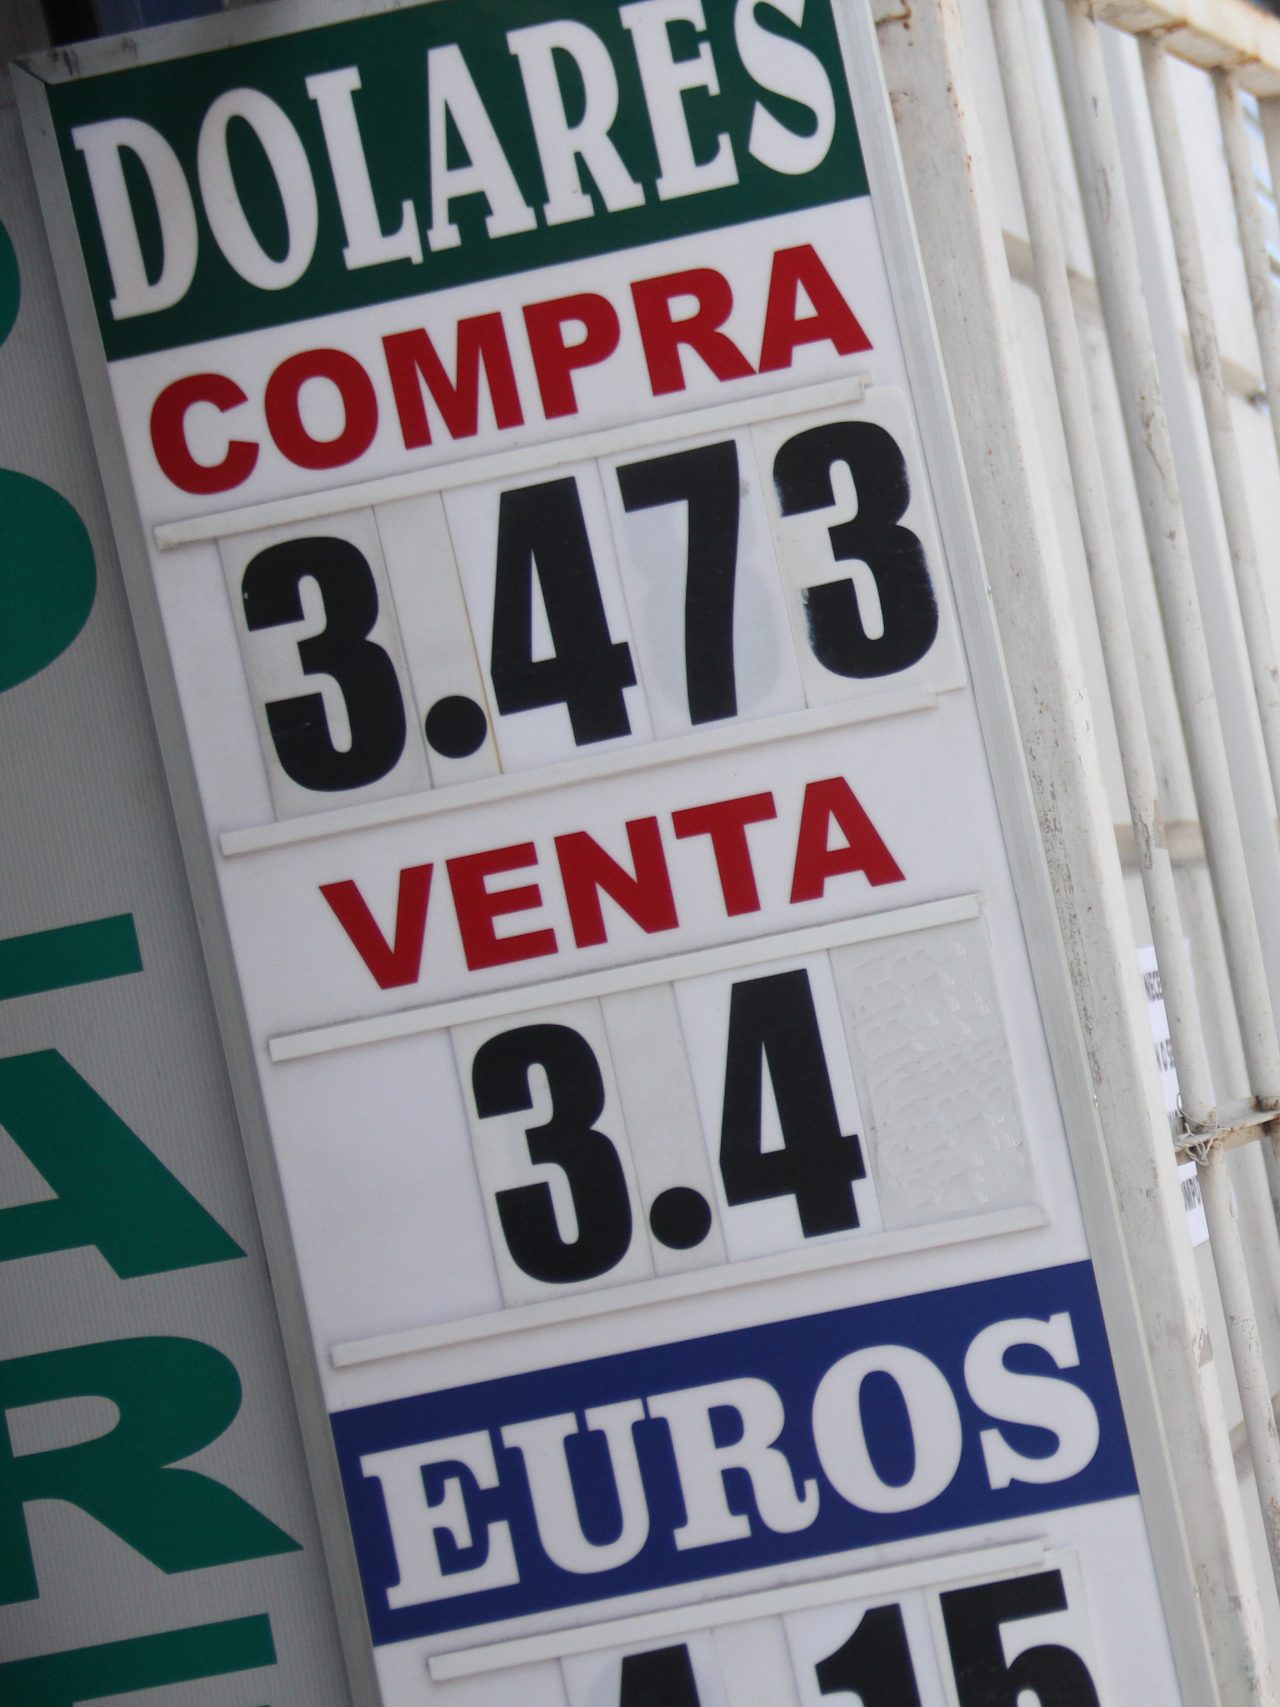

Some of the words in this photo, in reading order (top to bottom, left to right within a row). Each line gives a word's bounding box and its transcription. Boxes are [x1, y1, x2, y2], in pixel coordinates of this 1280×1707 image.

[72, 0, 837, 322] DOLARES
[150, 243, 874, 496] COMPRA
[241, 420, 940, 793] 3.473
[318, 775, 906, 990] VENTA
[471, 968, 867, 1285] 3.4
[359, 1312, 1100, 1610] EUROS
